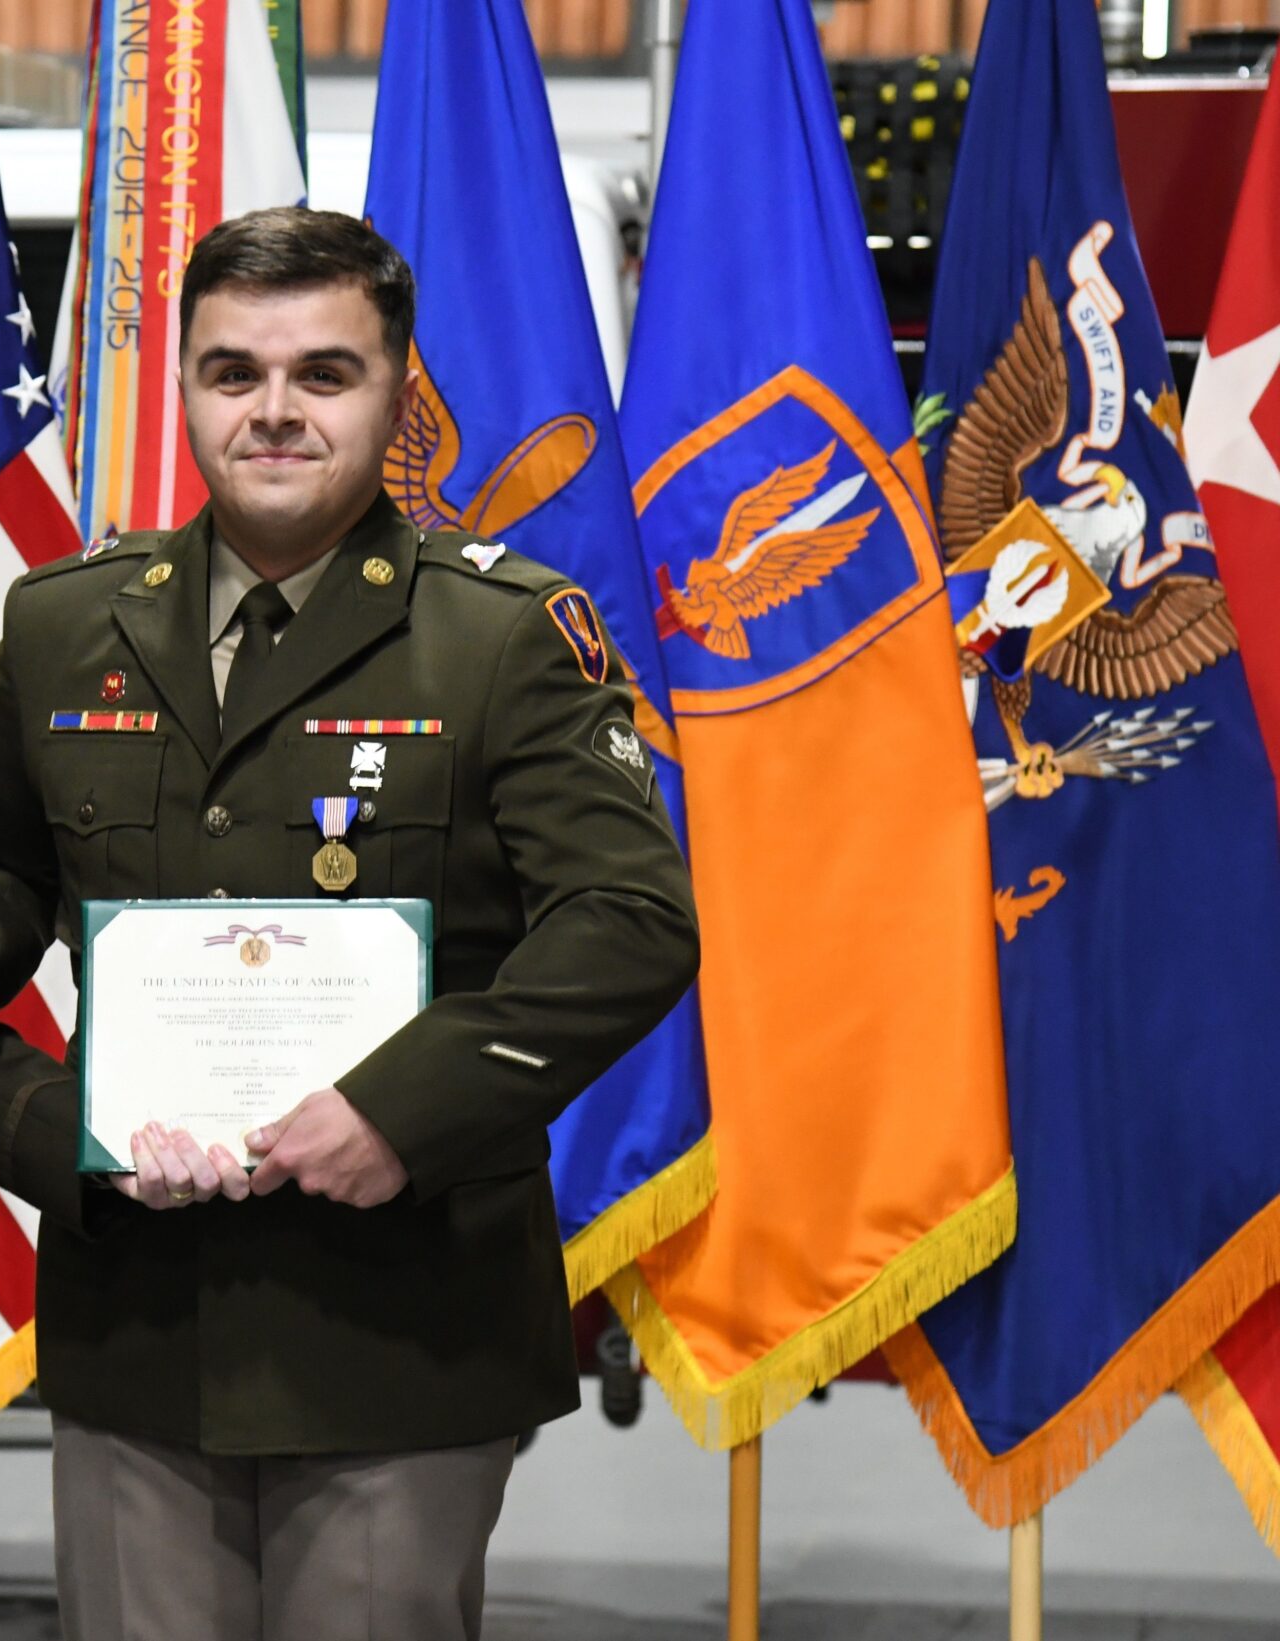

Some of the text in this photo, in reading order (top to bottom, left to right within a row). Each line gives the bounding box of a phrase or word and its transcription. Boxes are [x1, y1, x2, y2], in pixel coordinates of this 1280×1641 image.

[114, 126, 147, 223] 2014
[106, 257, 143, 352] 2015
[1080, 306, 1116, 433] SWIFT AND
[140, 977, 371, 987] THE UNITED STATES OF AMERICA
[194, 1038, 215, 1048] THE
